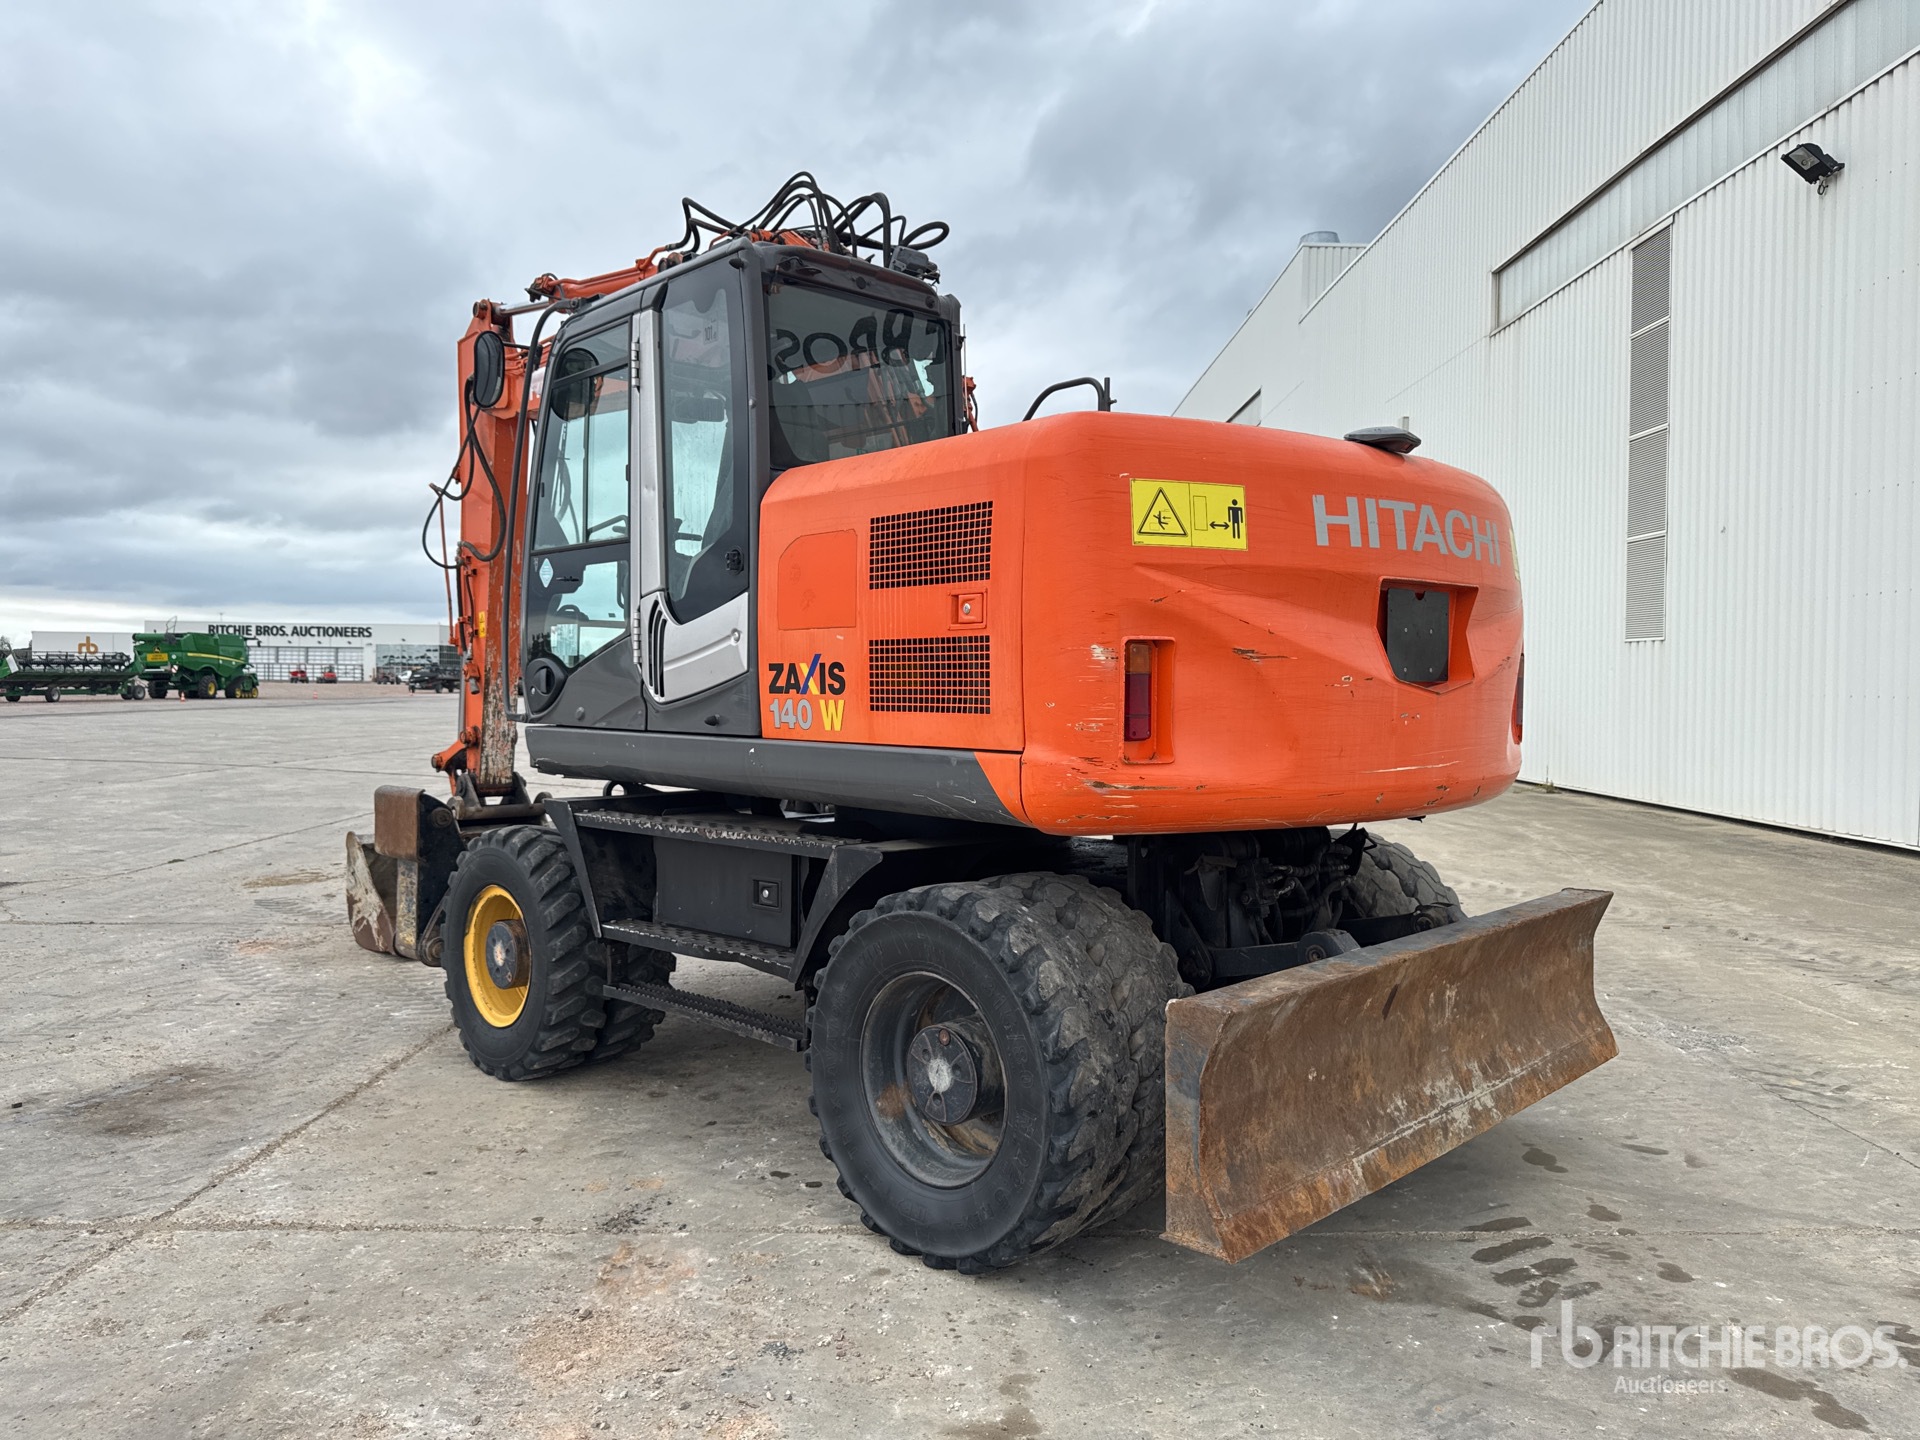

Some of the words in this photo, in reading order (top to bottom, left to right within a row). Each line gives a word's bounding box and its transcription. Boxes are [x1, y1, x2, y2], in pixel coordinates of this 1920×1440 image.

[1312, 494, 1501, 567] HITACHI
[208, 624, 252, 636] RITCHIE
[255, 625, 288, 637] BROS.
[290, 626, 373, 638] AUCTIONEERS
[768, 653, 846, 695] ZAXIS
[770, 698, 813, 730] 140
[819, 699, 845, 731] W
